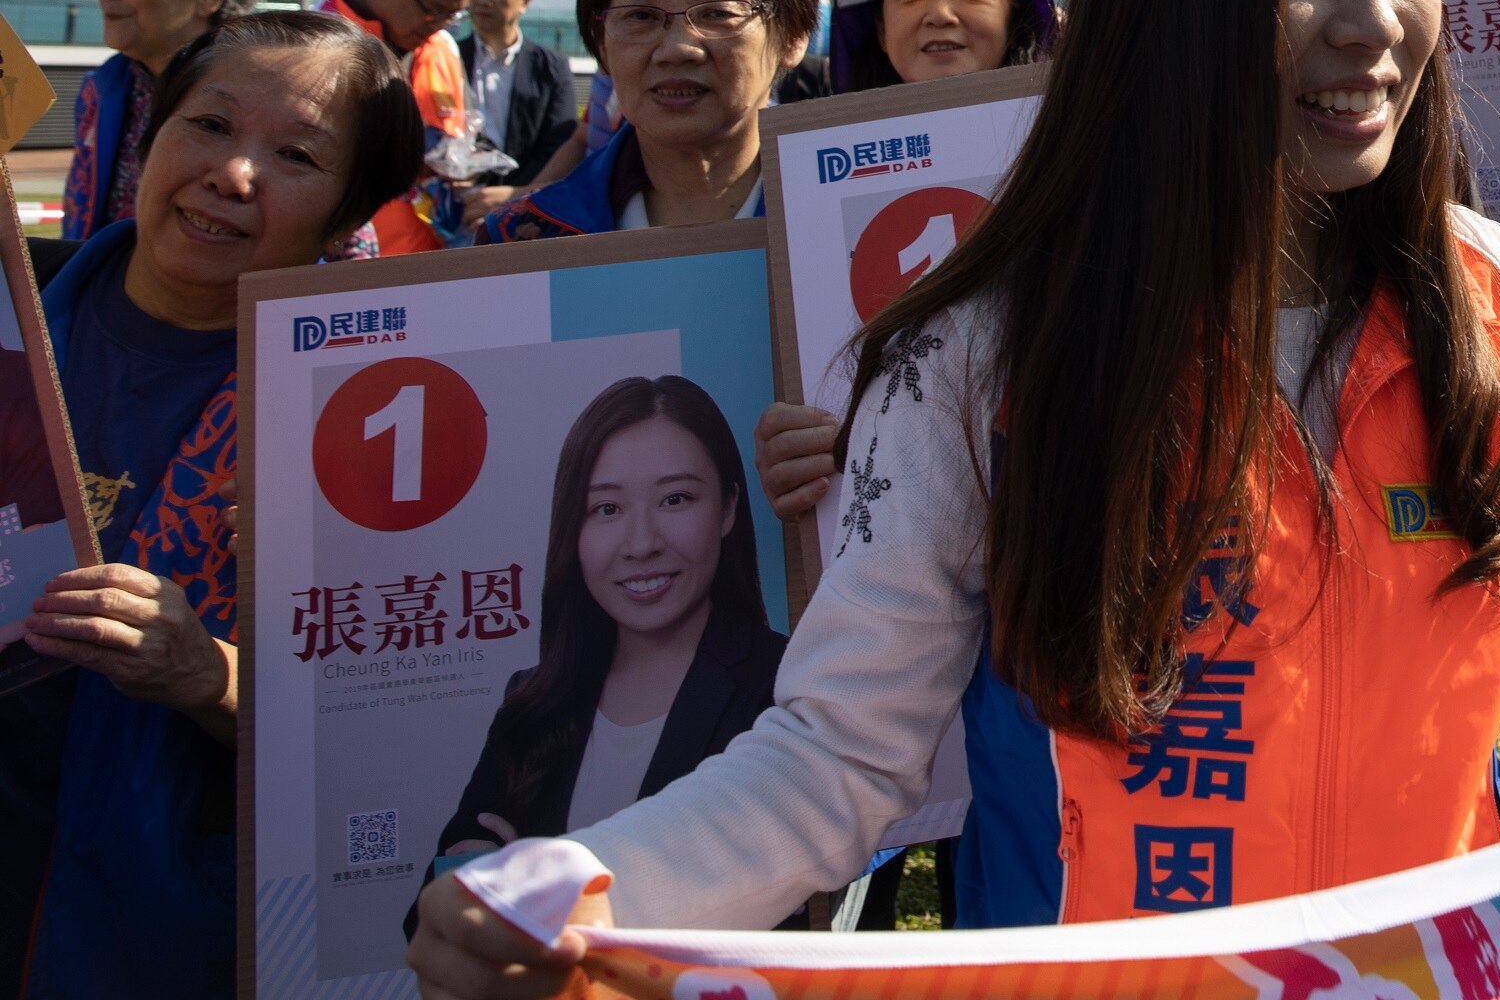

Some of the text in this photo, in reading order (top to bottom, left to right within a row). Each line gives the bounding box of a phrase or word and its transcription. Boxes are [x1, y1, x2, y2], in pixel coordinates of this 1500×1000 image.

[853, 133, 931, 167] 民建聯
[893, 158, 932, 173] DAB
[330, 306, 407, 337] 民建聯
[367, 331, 407, 344] DAB
[363, 385, 426, 502] 1
[291, 563, 531, 663] 張嘉恩
[323, 646, 485, 680] Cheung Ka Yan Iris
[318, 685, 492, 715] Candidate of Tung Wah Constituency
